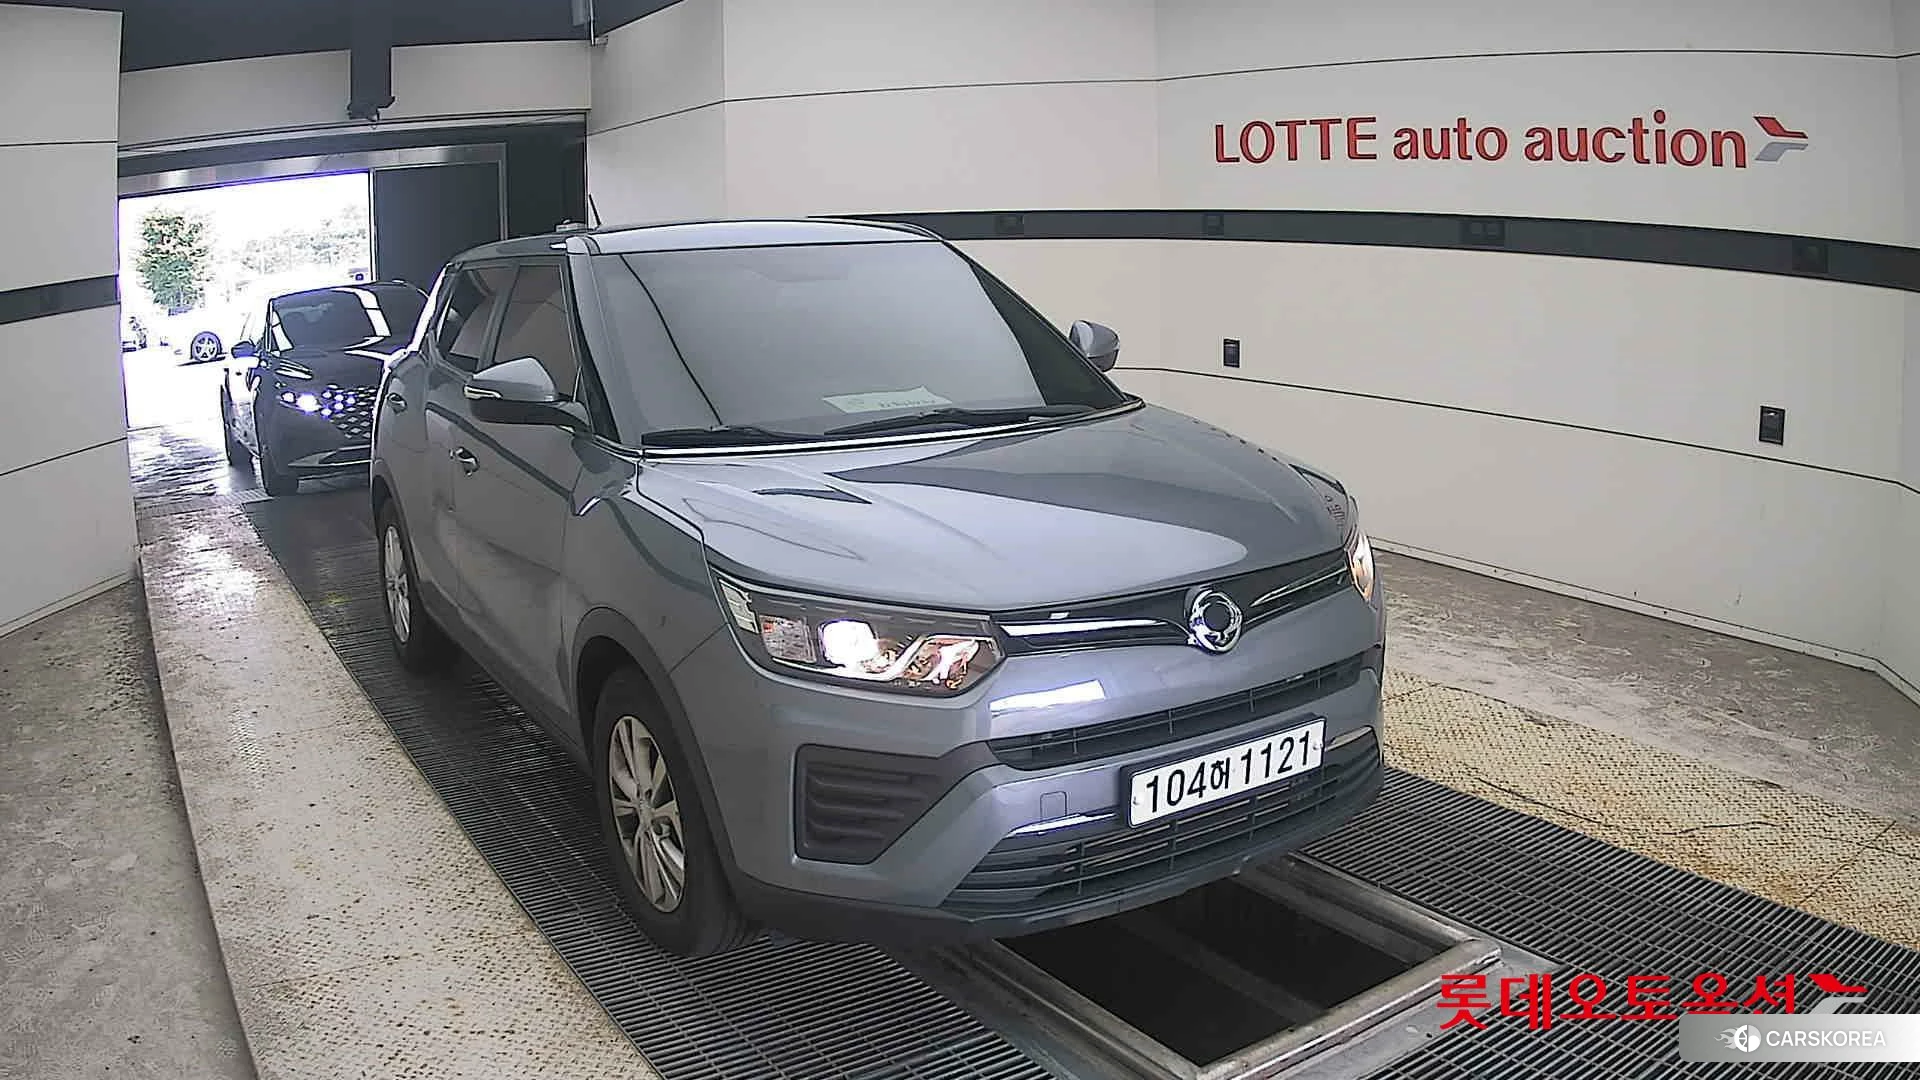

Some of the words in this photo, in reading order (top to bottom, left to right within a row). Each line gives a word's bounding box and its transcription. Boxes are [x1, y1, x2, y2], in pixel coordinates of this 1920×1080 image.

[1214, 116, 1377, 164] LOTTE
[1393, 116, 1509, 162] auto
[1523, 109, 1747, 169] auction
[1240, 730, 1310, 785] 1121
